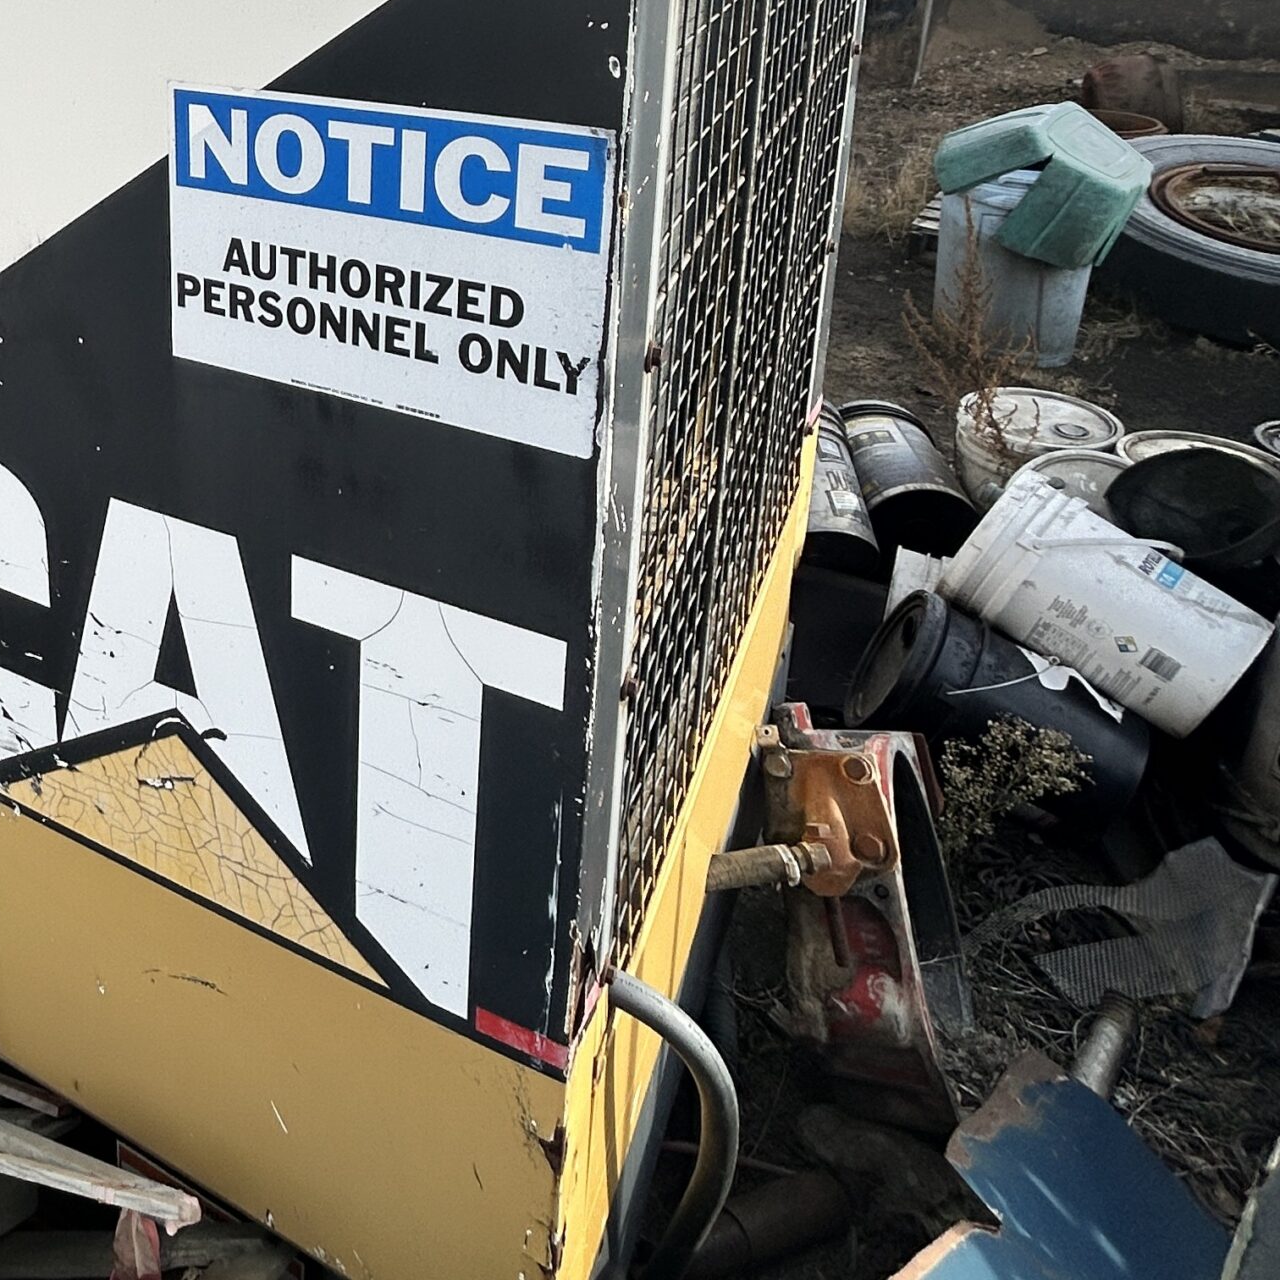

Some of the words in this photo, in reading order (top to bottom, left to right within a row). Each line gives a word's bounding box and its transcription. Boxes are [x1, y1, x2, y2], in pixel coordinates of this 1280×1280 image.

[188, 103, 589, 239] NOTICE
[176, 272, 439, 365] PERSONNEL
[458, 332, 591, 396] ONLY
[222, 237, 525, 328] AUTHORIZED
